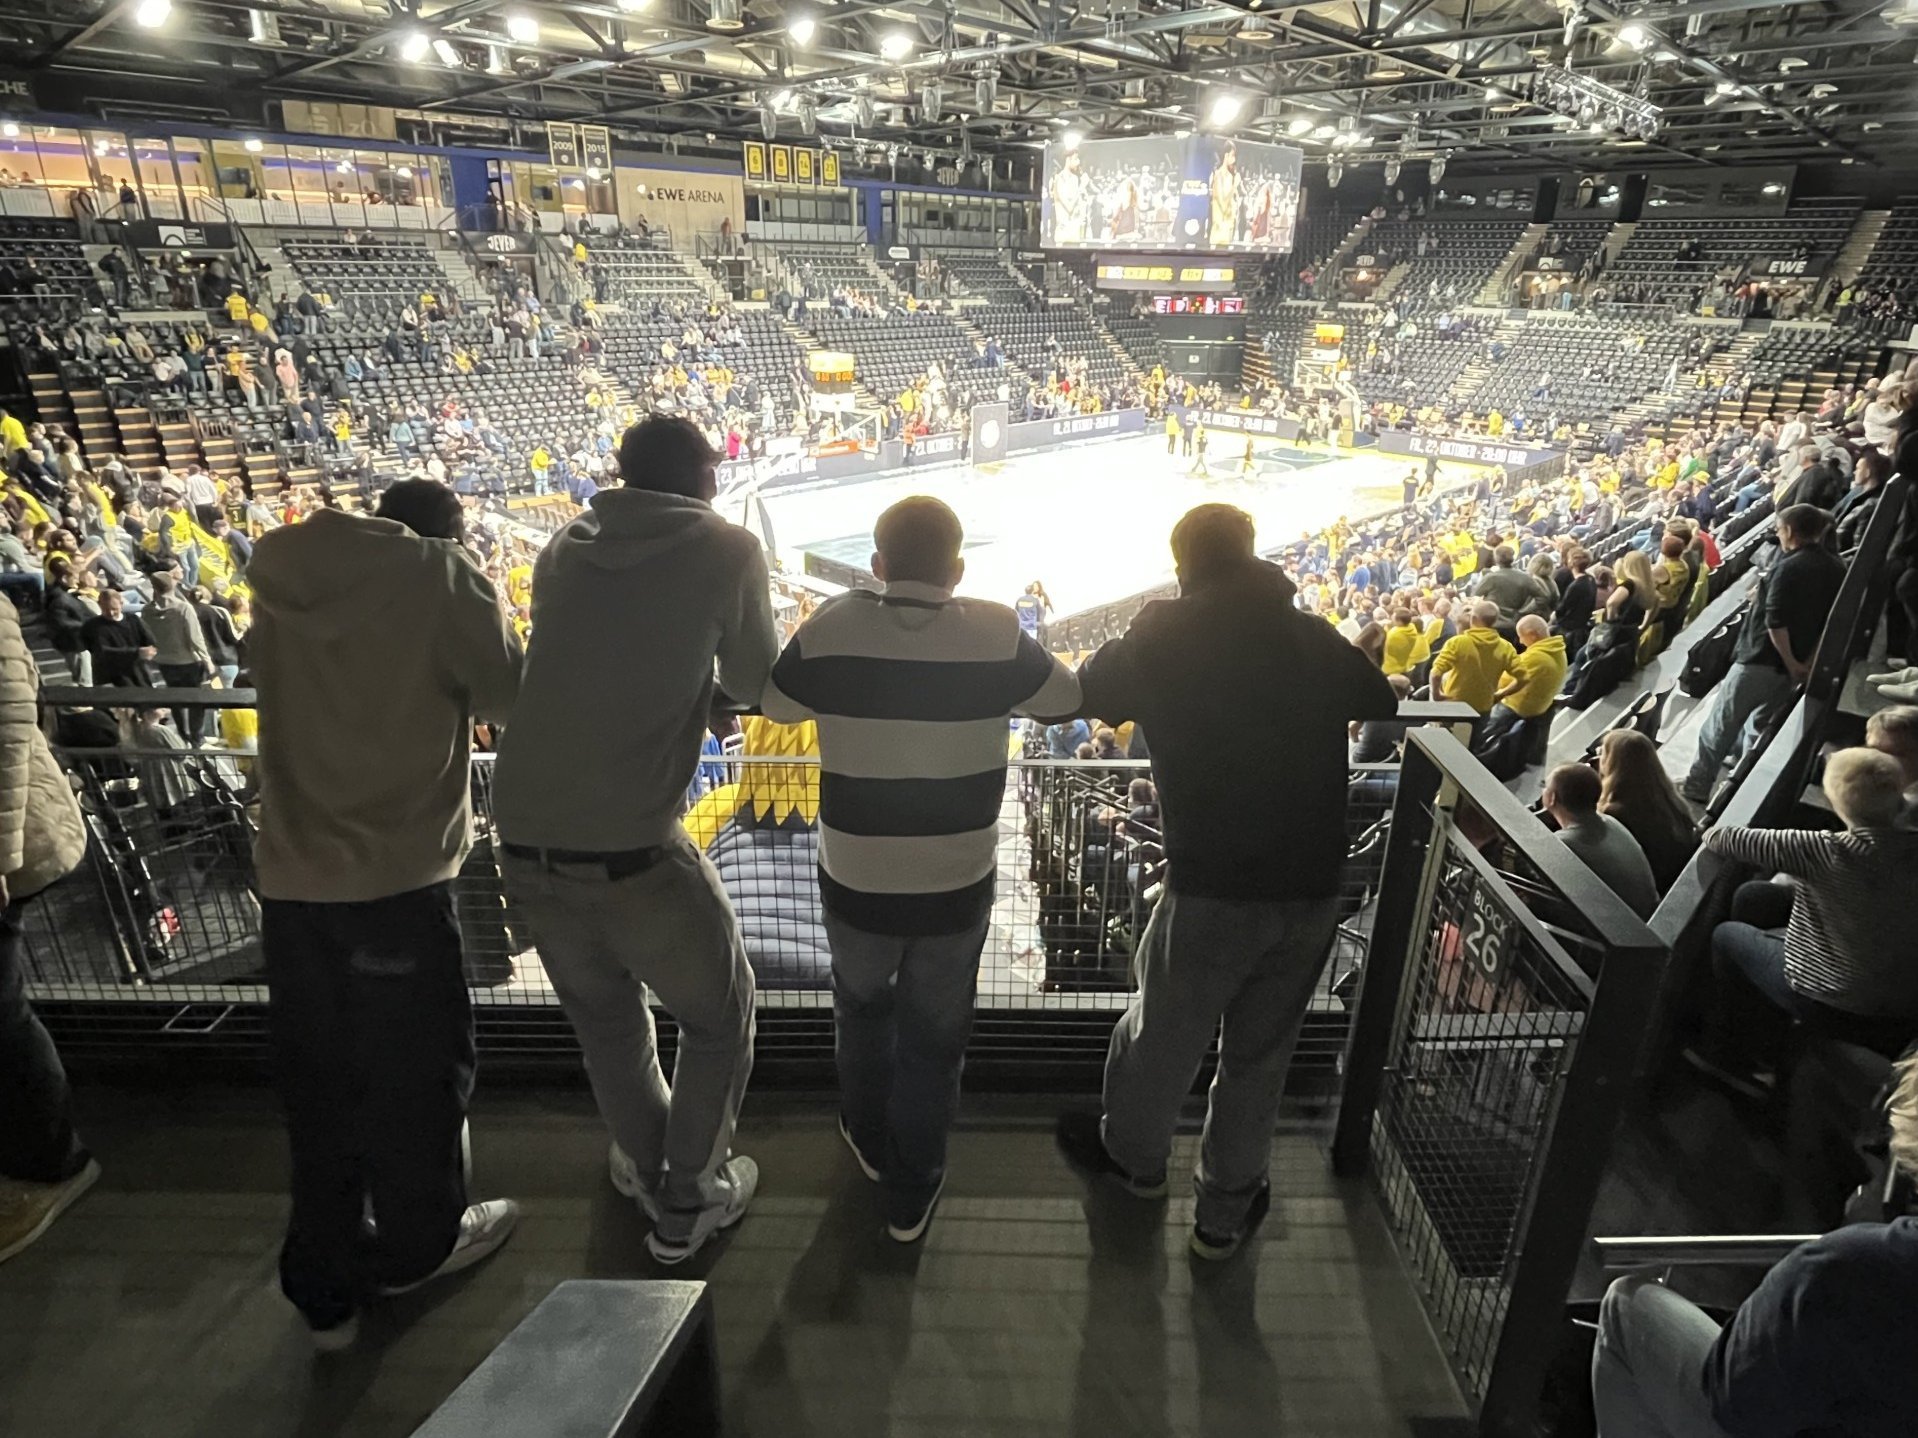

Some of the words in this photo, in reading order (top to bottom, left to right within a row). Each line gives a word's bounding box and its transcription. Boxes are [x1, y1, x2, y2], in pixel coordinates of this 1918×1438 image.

[552, 140, 574, 151] 2009
[586, 143, 607, 154] 2015
[657, 188, 686, 201] EWE
[687, 190, 725, 204] ARENA
[1768, 261, 1808, 273] EWE
[1474, 889, 1509, 940] BLOCK
[1466, 912, 1501, 973] 26
